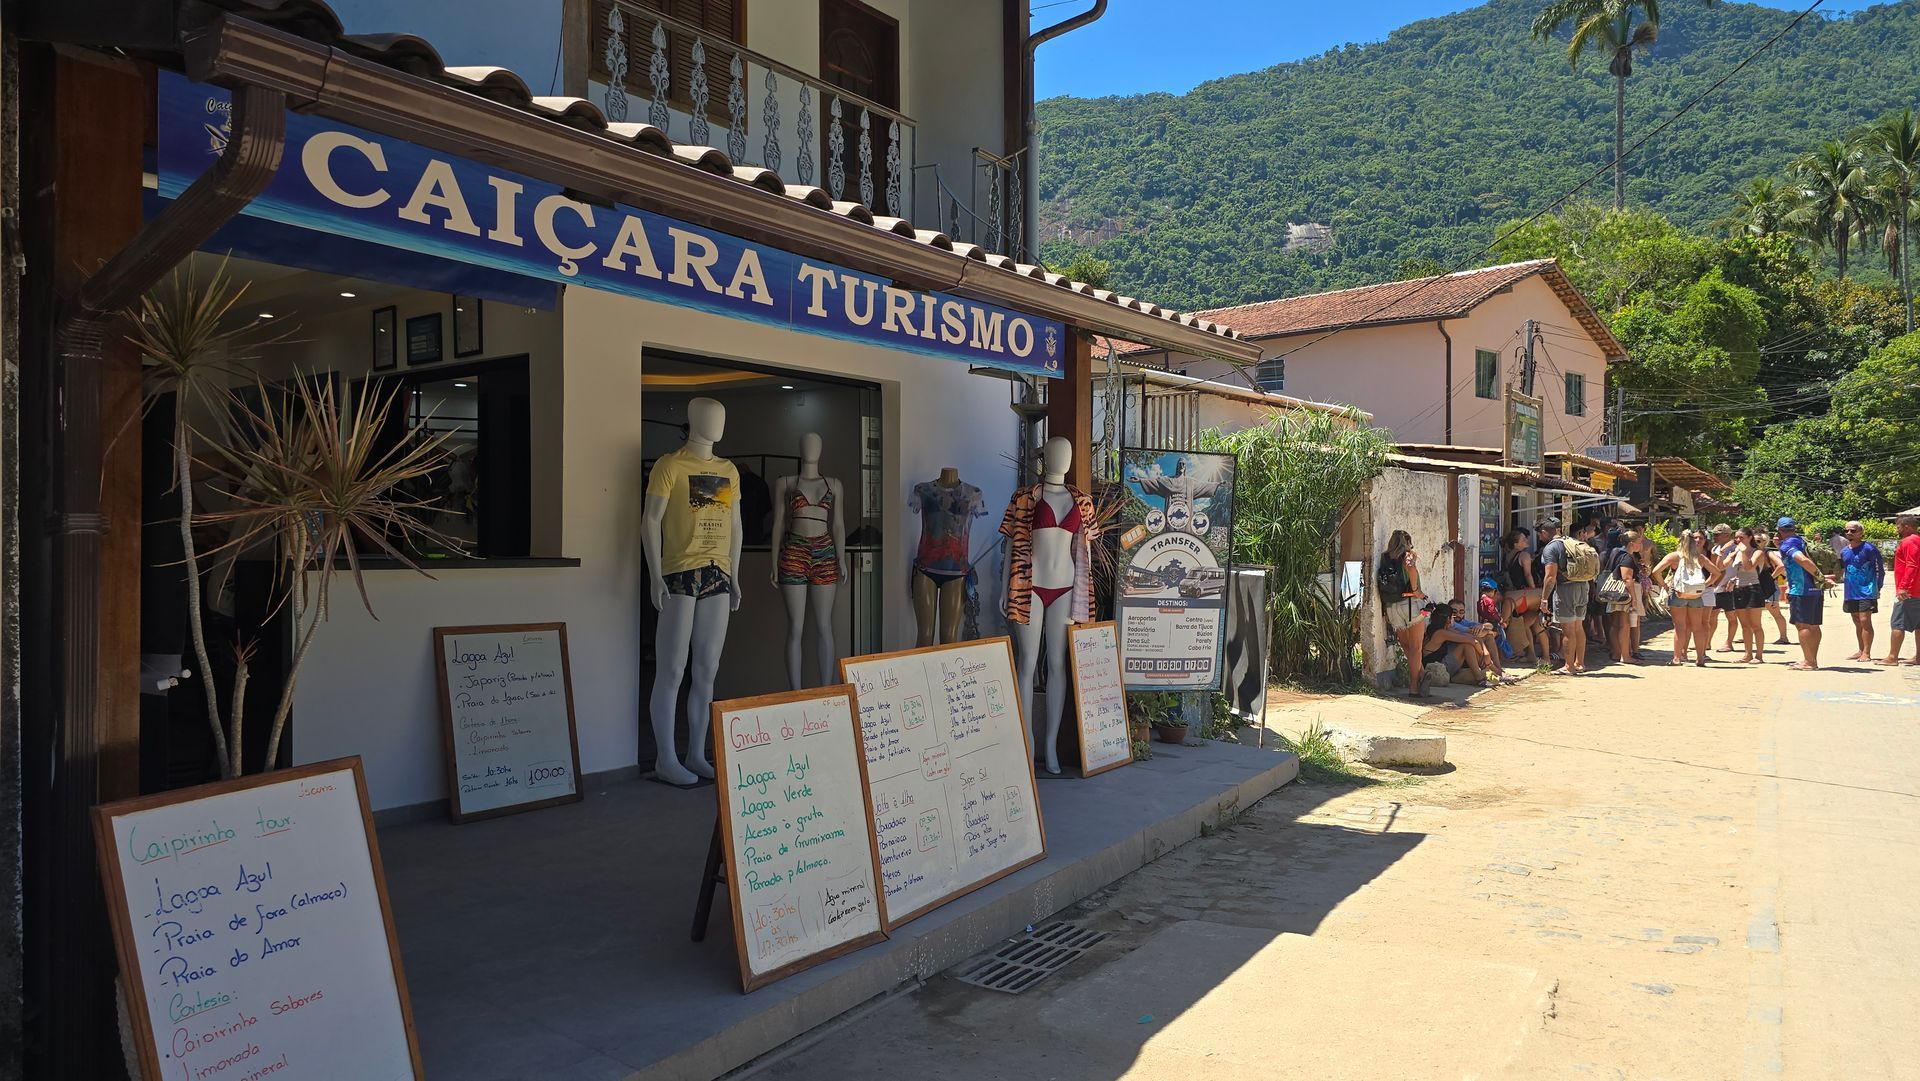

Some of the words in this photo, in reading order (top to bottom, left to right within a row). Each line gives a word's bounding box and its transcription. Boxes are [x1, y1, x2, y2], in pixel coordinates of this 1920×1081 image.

[302, 131, 773, 305] CAIÇARA
[798, 263, 1034, 357] TURISMO
[1150, 537, 1201, 554] TRANSFER
[452, 640, 487, 670] Lagoa
[494, 642, 514, 664] Azul
[851, 669, 874, 694] Meia
[880, 668, 899, 688] Volta
[730, 715, 771, 748] Gruta
[780, 718, 794, 738] do
[738, 764, 776, 795] Lagoa
[787, 754, 810, 780] Azul
[741, 796, 776, 820] Lagoa
[784, 784, 813, 802] Verde
[744, 824, 777, 845] Acesso
[797, 805, 824, 832] gruta
[744, 847, 773, 867] Praia
[156, 878, 222, 916] Lagoa
[235, 862, 273, 893] Azul
[745, 870, 783, 893] Parada
[153, 921, 215, 951] Praia
[229, 914, 248, 931] de
[255, 904, 288, 935] fora
[290, 882, 348, 910] (almoço)
[159, 956, 217, 987] Praia
[230, 948, 249, 967] do
[261, 937, 301, 959] Amor
[270, 990, 323, 1016] Sabores
